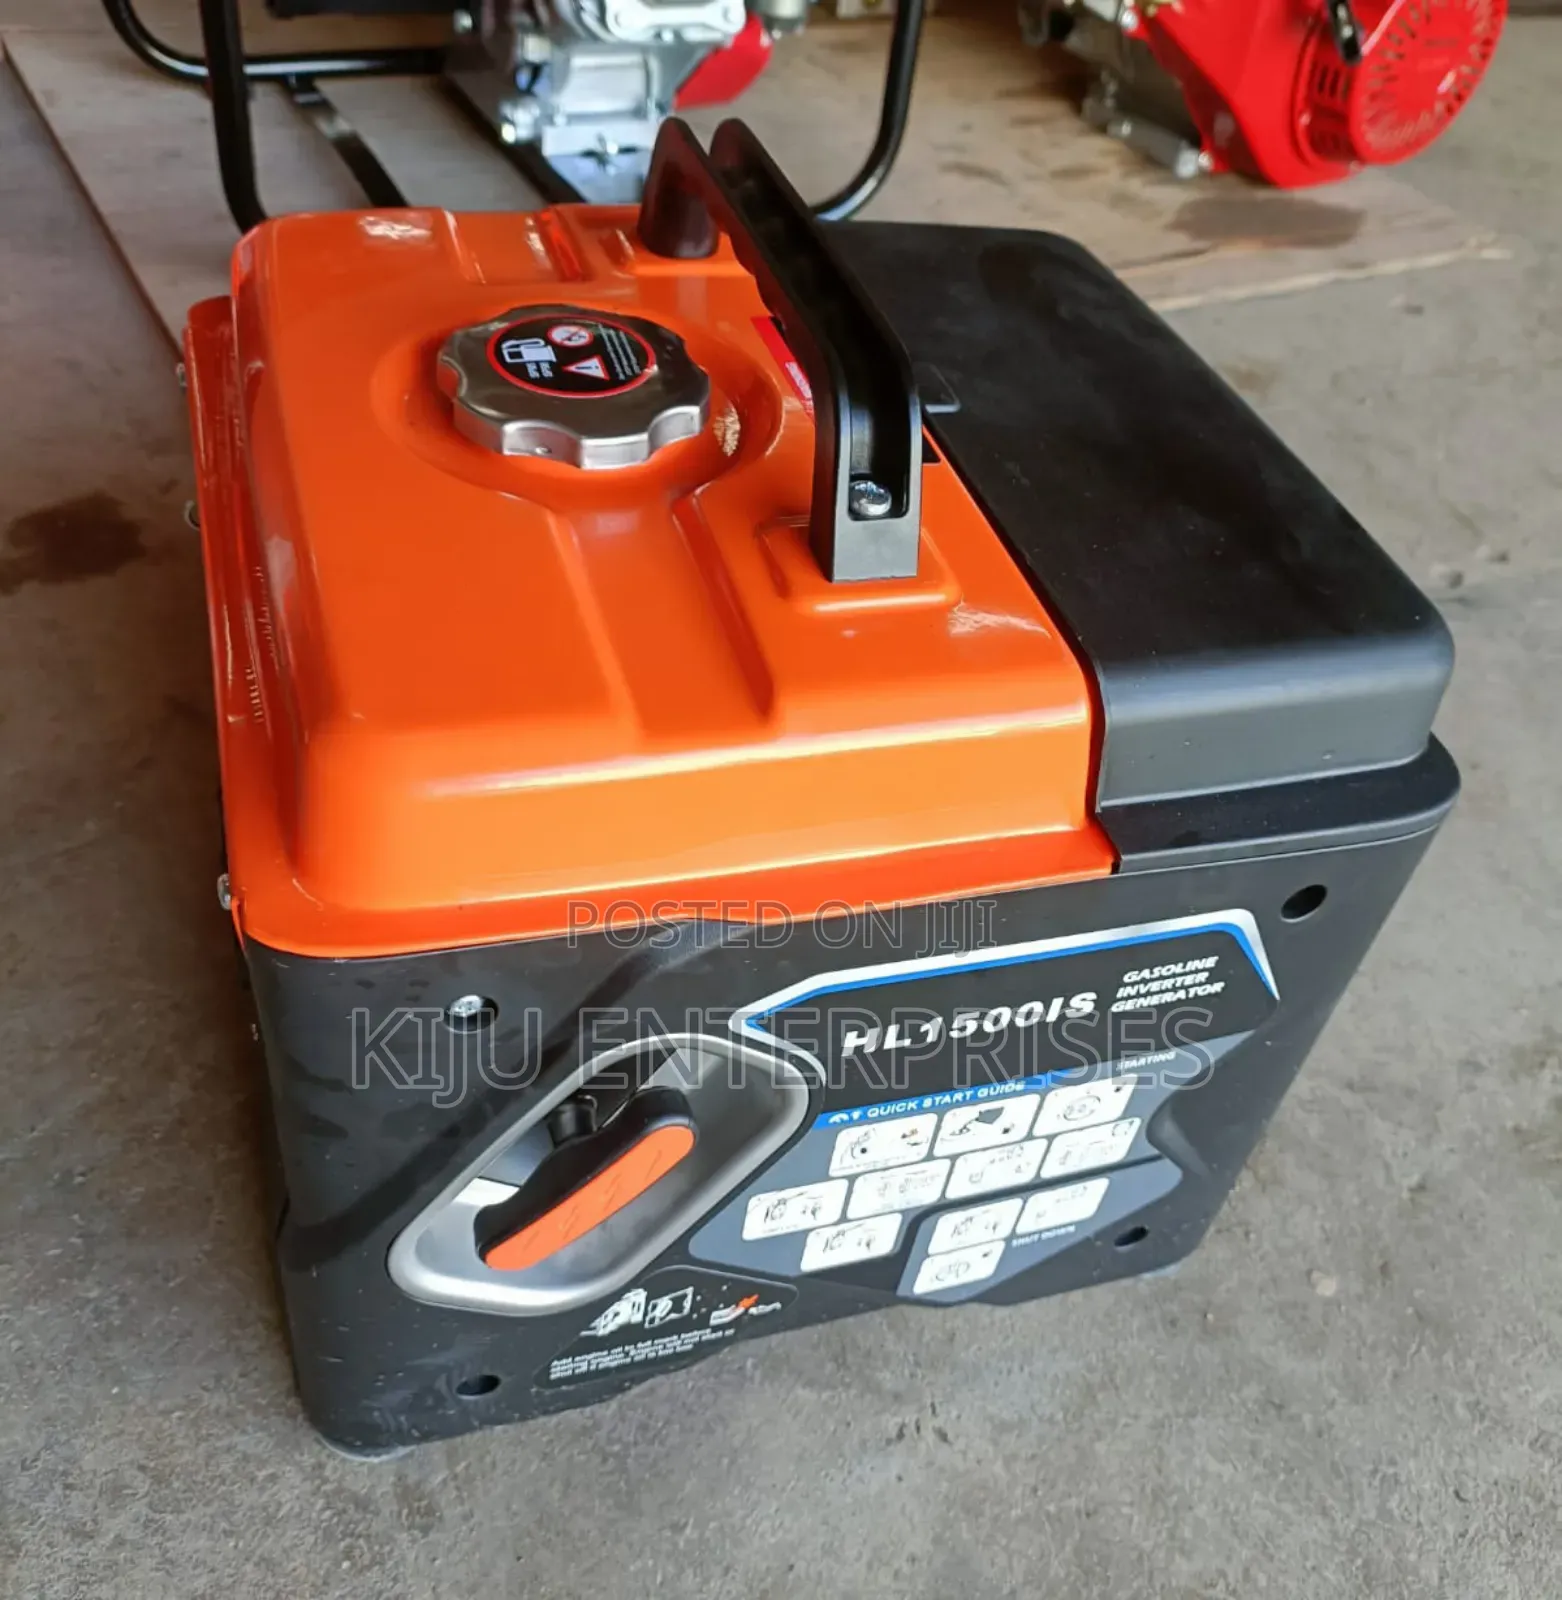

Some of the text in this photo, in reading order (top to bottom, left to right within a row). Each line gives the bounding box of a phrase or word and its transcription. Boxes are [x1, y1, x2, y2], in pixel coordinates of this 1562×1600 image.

[1116, 971, 1210, 999] INVERTER
[1122, 955, 1220, 983] GASOLINE
[1110, 981, 1226, 1013] GENERATOR
[841, 991, 1098, 1058] HL1500IS
[866, 1080, 1027, 1119] QUICK START GUIDE
